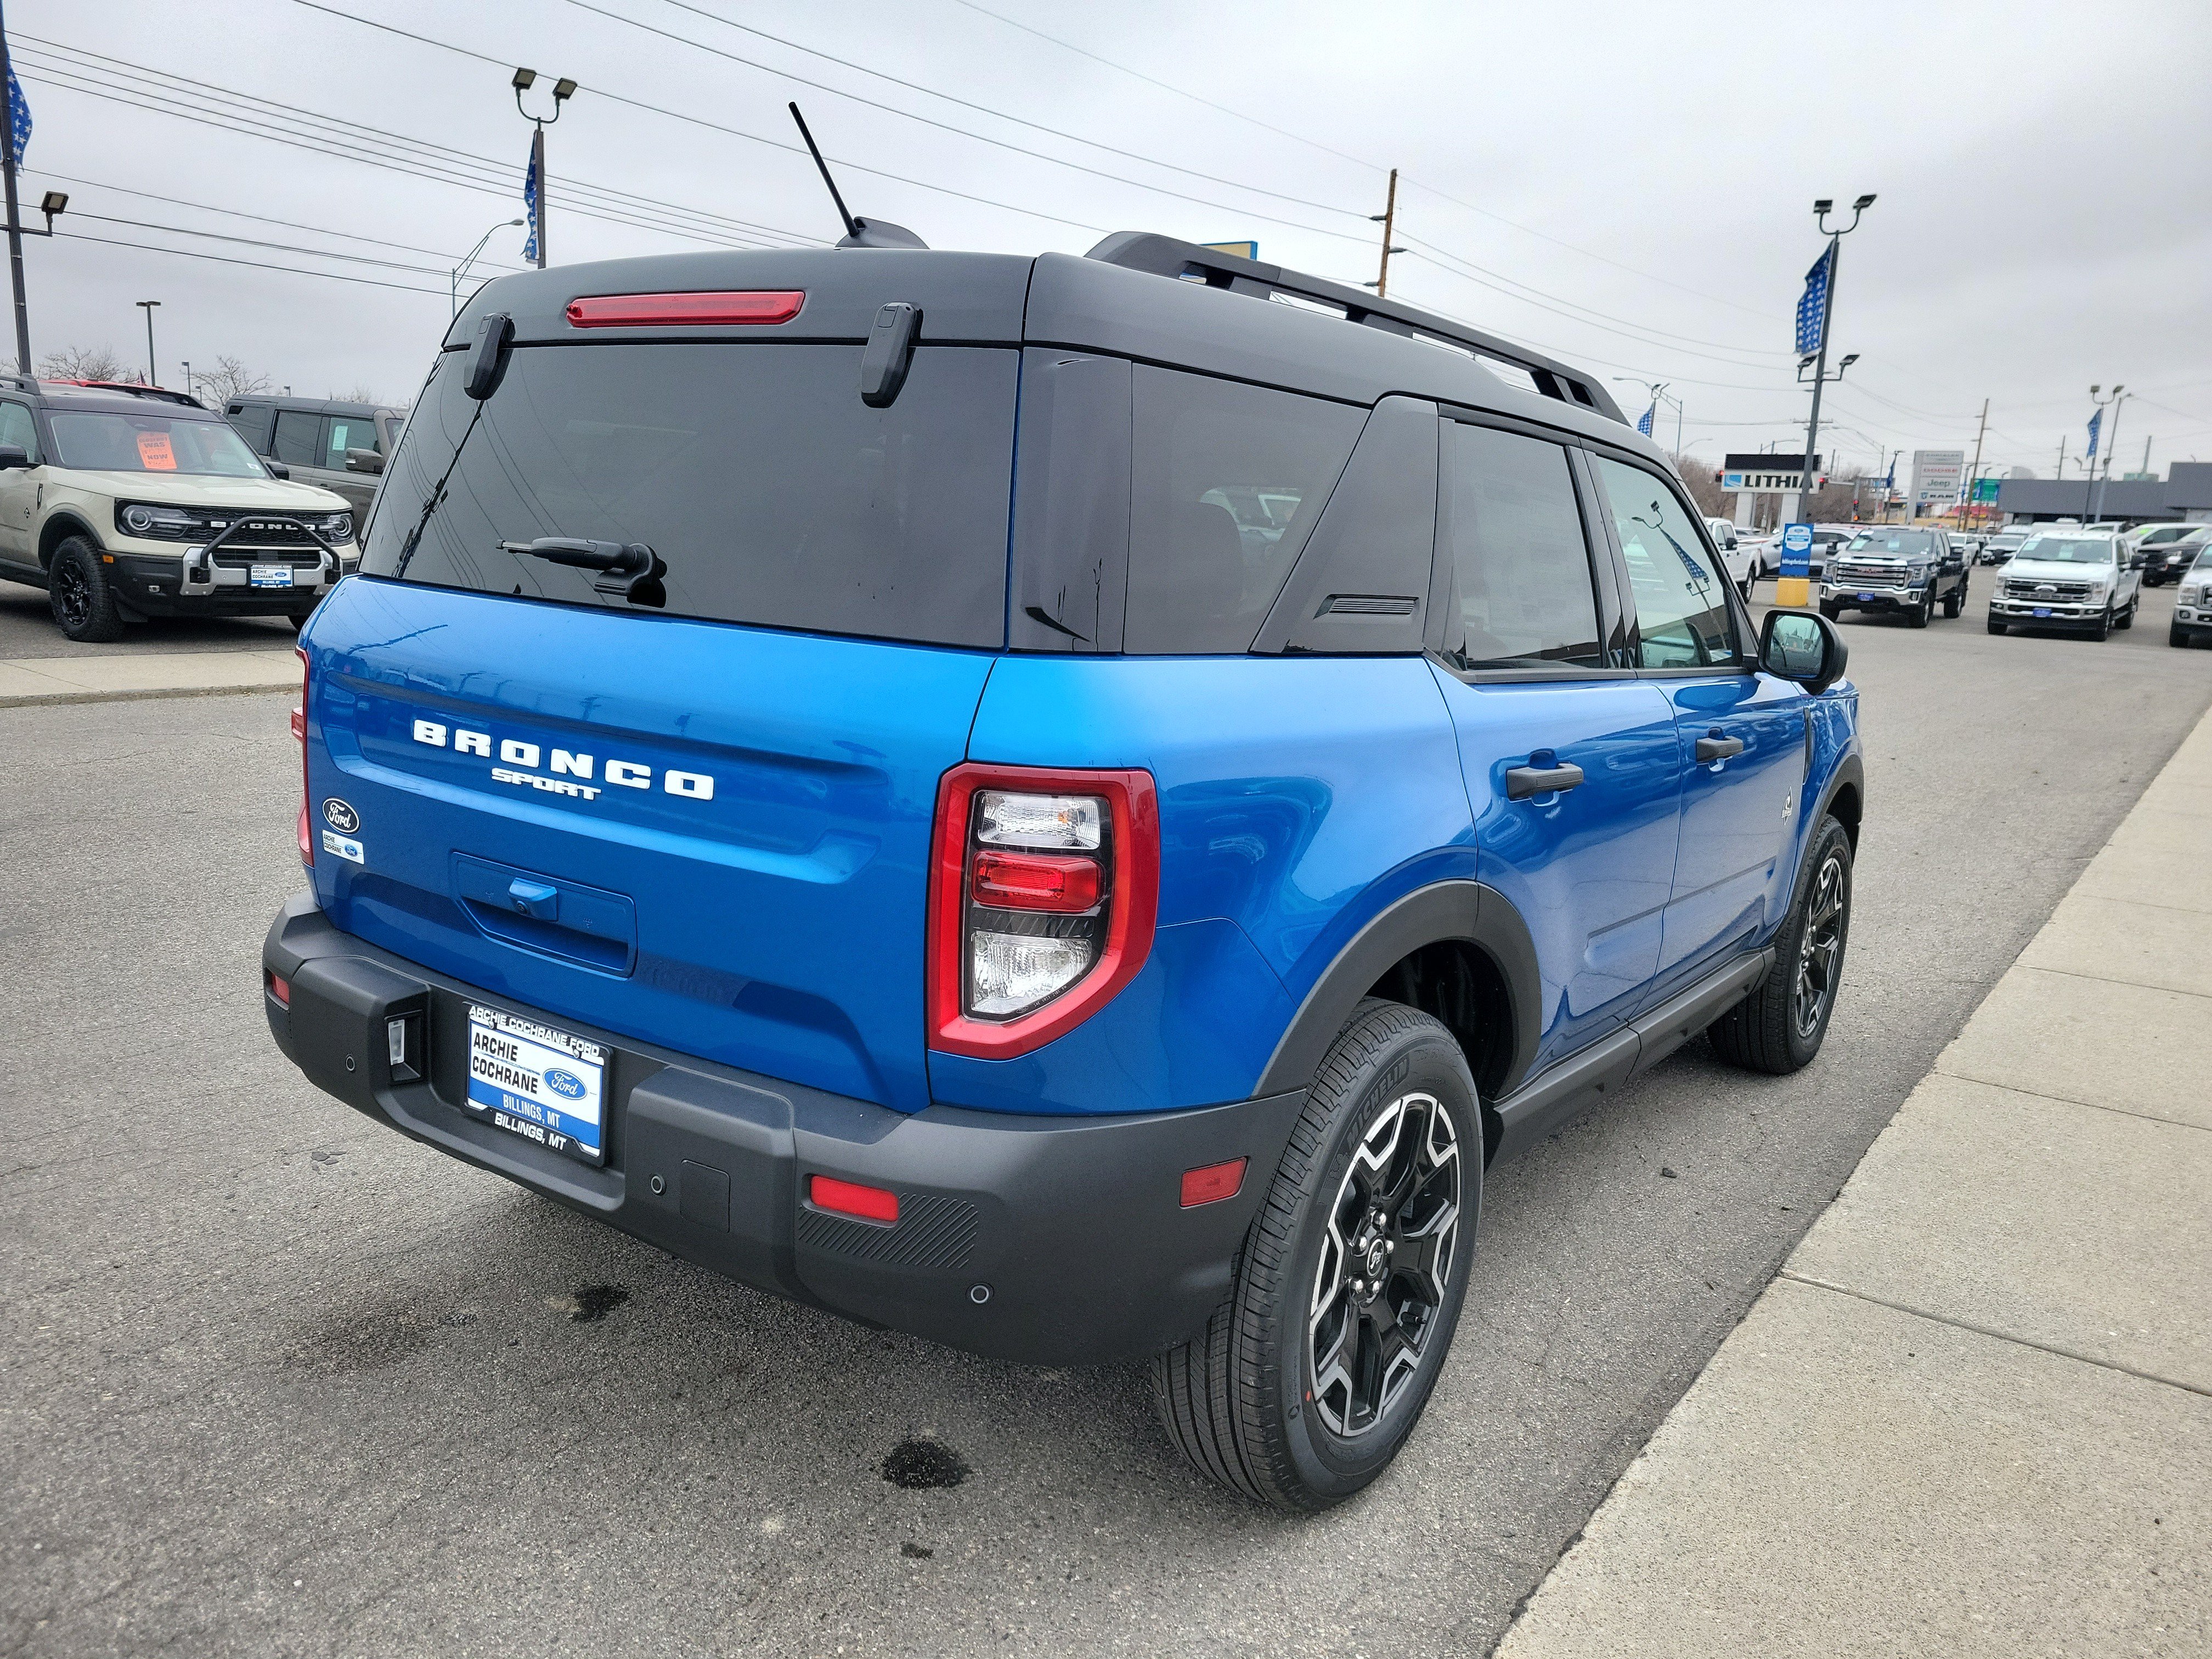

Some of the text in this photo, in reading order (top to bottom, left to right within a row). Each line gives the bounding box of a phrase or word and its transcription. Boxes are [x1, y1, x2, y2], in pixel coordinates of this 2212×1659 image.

[1928, 479, 1950, 487] Jeep
[414, 719, 714, 800] BRONCO
[492, 768, 601, 800] SPORT
[329, 803, 351, 828] Ford
[324, 833, 335, 843] ARCHIE
[324, 842, 341, 854] COCHRANE
[347, 846, 356, 855] Ford
[469, 1006, 600, 1057] ARCHIE COCHRANE FORD
[473, 1032, 518, 1062] ARCHIE
[472, 1055, 539, 1094] COCHRANE
[551, 1072, 578, 1096] Ford
[503, 1094, 560, 1128] BILLINGS, MT
[1346, 1058, 1408, 1150] MICHELIN
[495, 1113, 567, 1150] BILLINGS, MT
